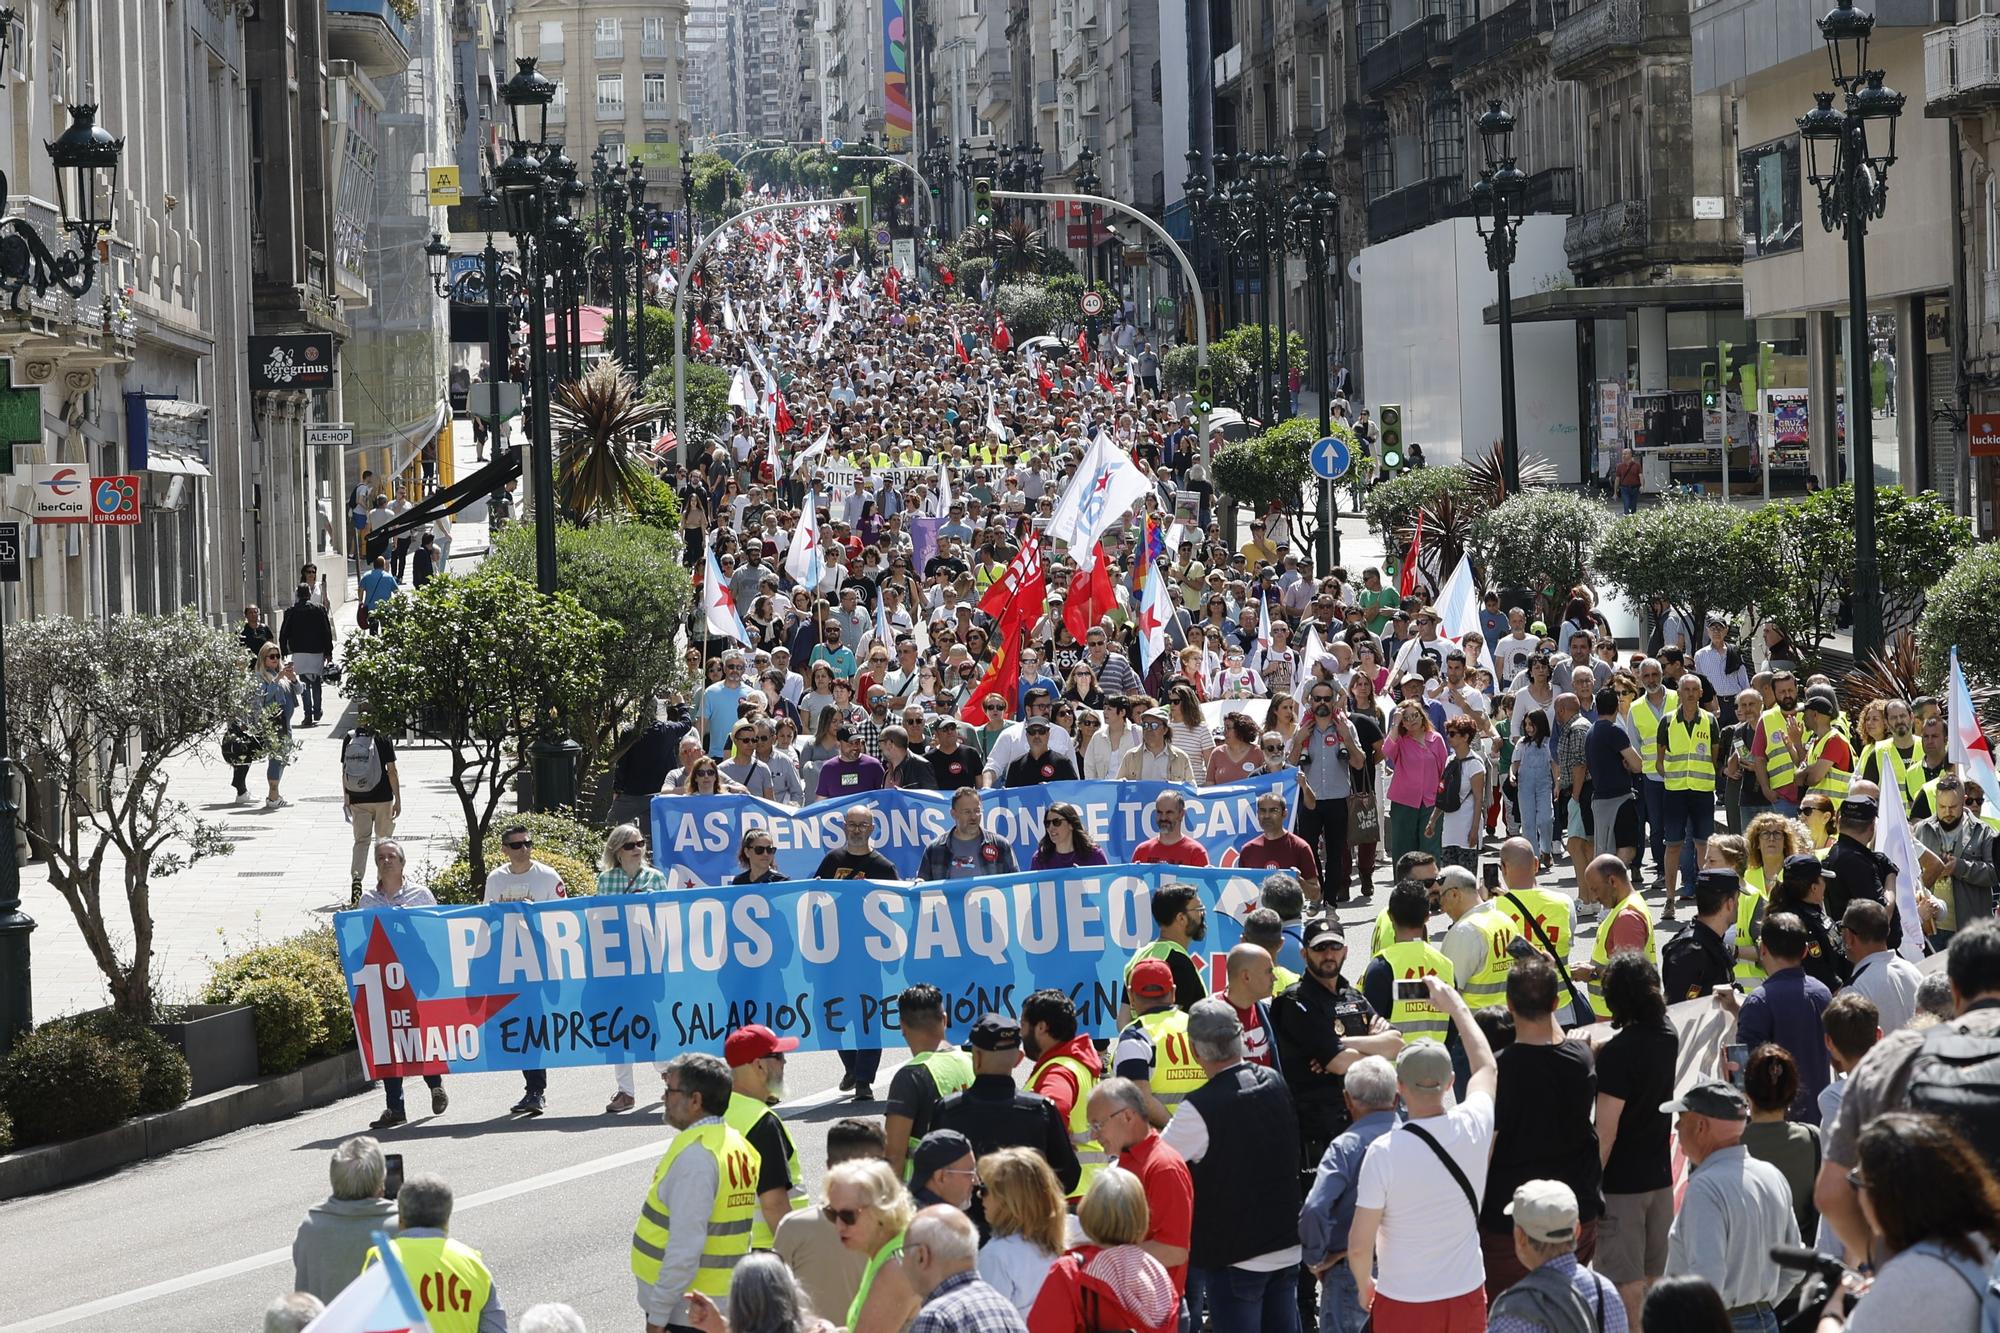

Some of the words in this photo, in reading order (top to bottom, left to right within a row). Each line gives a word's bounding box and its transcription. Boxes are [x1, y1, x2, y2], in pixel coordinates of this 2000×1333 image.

[1086, 299, 1099, 307] 40
[263, 362, 329, 376] Peregrinus
[37, 502, 83, 513] iberCaja
[116, 513, 138, 521] 6000
[673, 812, 729, 852] AS
[741, 801, 945, 851] PENSÓNS
[446, 894, 774, 988] PAREMOS
[796, 890, 840, 964] O
[862, 873, 1176, 964] SAQUEO
[390, 1009, 411, 1027] DE
[500, 1006, 658, 1054] EMPREGO,
[672, 992, 812, 1047] SALARIOS
[823, 997, 846, 1033] E
[860, 982, 1018, 1035] PEIÓNS
[392, 1023, 481, 1063] MAIO
[420, 1271, 472, 1313] CIG
